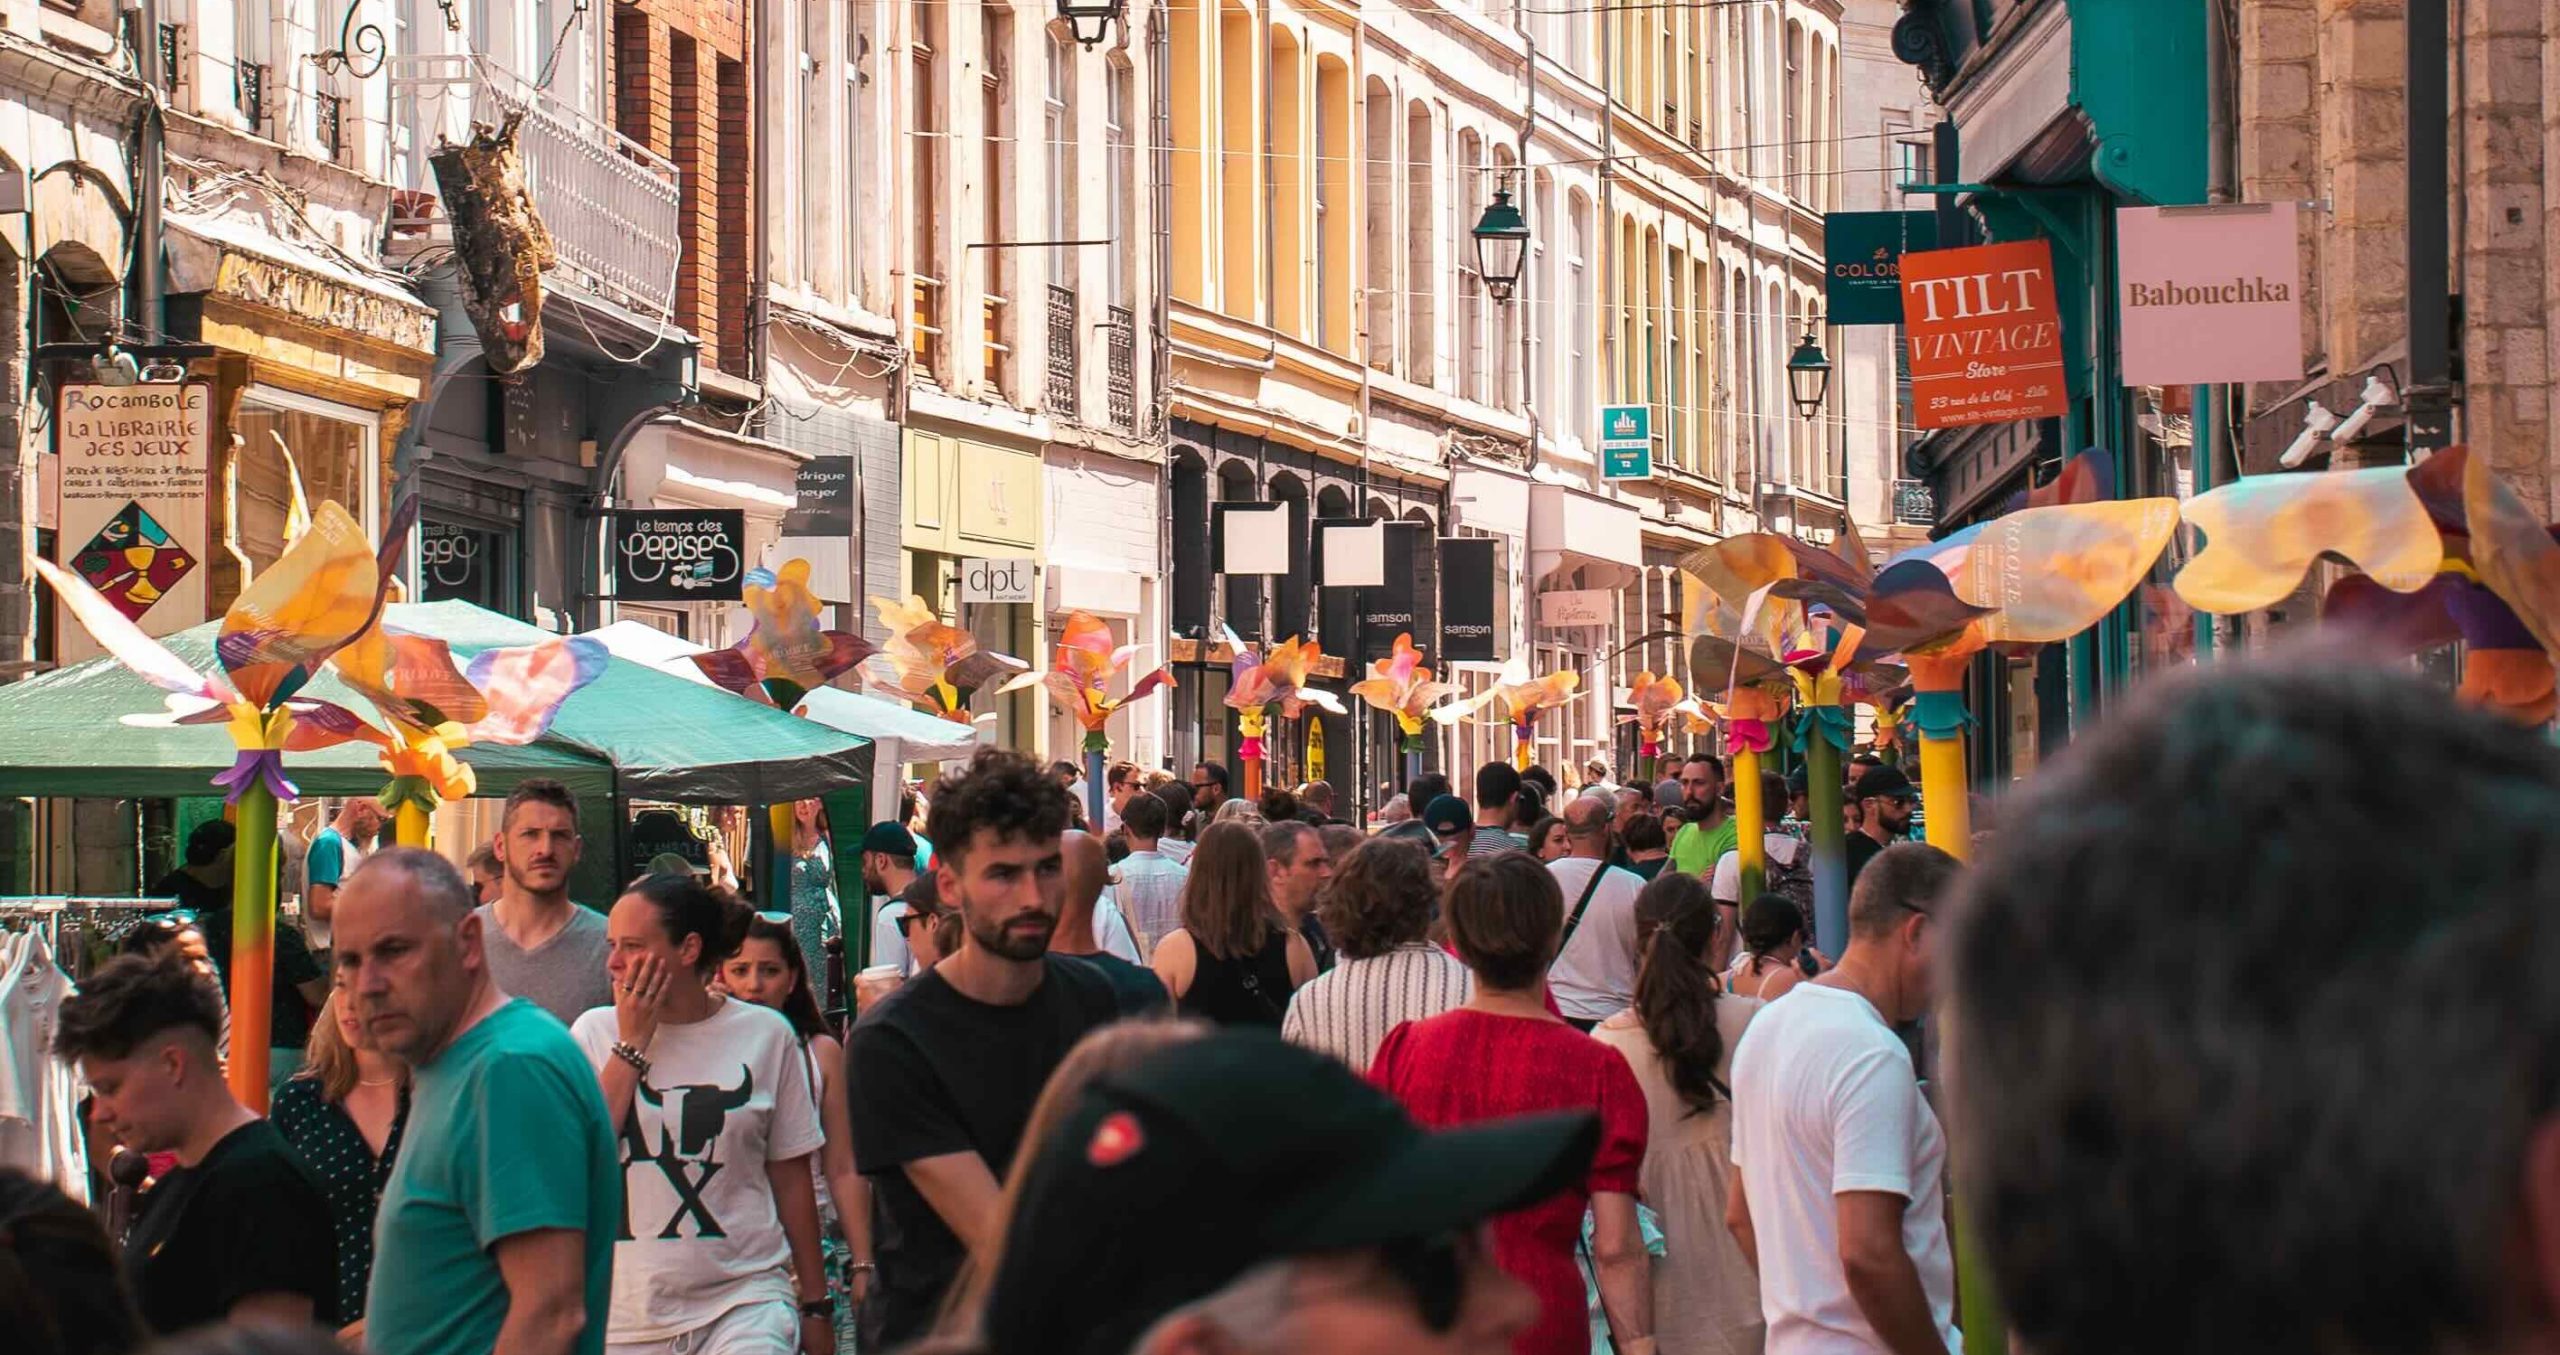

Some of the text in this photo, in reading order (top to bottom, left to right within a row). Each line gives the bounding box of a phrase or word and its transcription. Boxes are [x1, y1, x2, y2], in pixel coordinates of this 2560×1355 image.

[1910, 268, 2042, 322] TILT
[2128, 276, 2290, 307] Babouchka
[1911, 321, 2055, 361] VINTAGE
[1965, 360, 2007, 379] Store
[1929, 395, 1949, 409] 33
[1950, 398, 1966, 406] rue
[1967, 393, 1979, 404] de
[1980, 391, 1991, 403] la
[1992, 389, 2013, 402] Clef
[2024, 384, 2048, 398] Lille
[1940, 405, 2043, 423] www.tilt-vintage.com
[636, 520, 722, 535] Le temps des
[970, 561, 1026, 600] dpt
[1366, 612, 1411, 623] samson
[1444, 624, 1491, 634] samson
